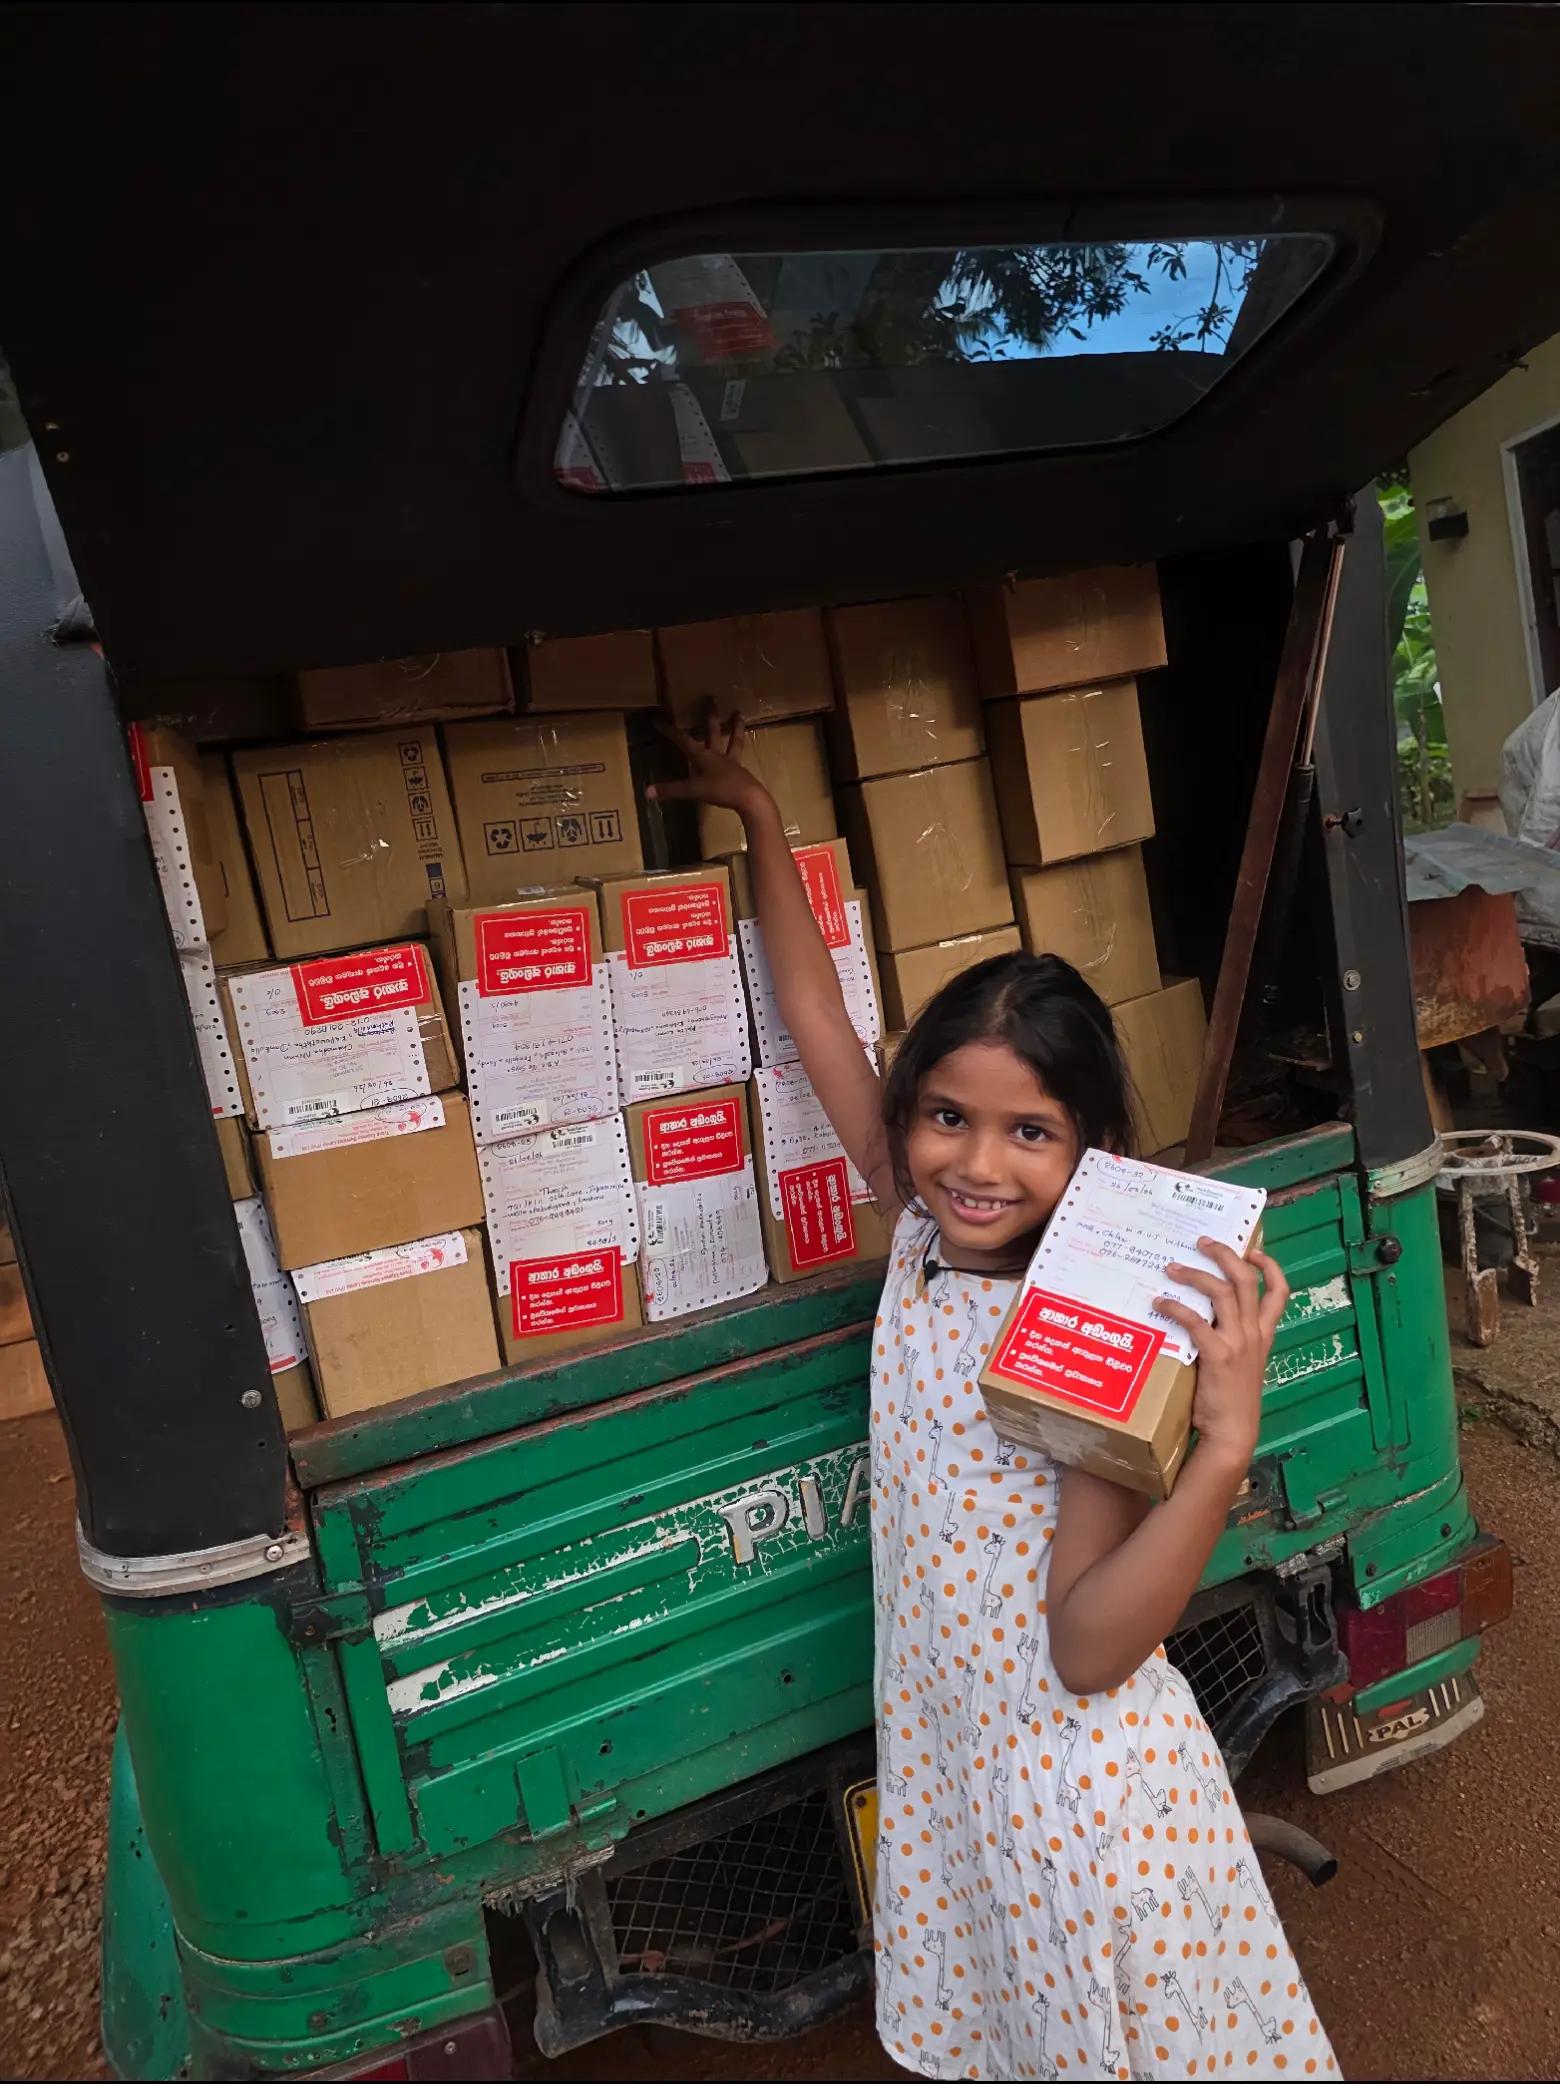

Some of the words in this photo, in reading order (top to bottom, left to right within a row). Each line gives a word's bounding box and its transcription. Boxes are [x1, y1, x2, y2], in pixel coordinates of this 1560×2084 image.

[686, 936, 713, 950] ආහාර
[543, 963, 575, 978] ආහාර
[372, 979, 408, 999] ආහාර
[659, 1117, 687, 1131] ආහාර
[827, 1174, 840, 1202] ආහාර
[528, 1267, 559, 1282] ආහාර
[1038, 1307, 1078, 1328] ආහාර
[1376, 1714, 1422, 1740] PAL
